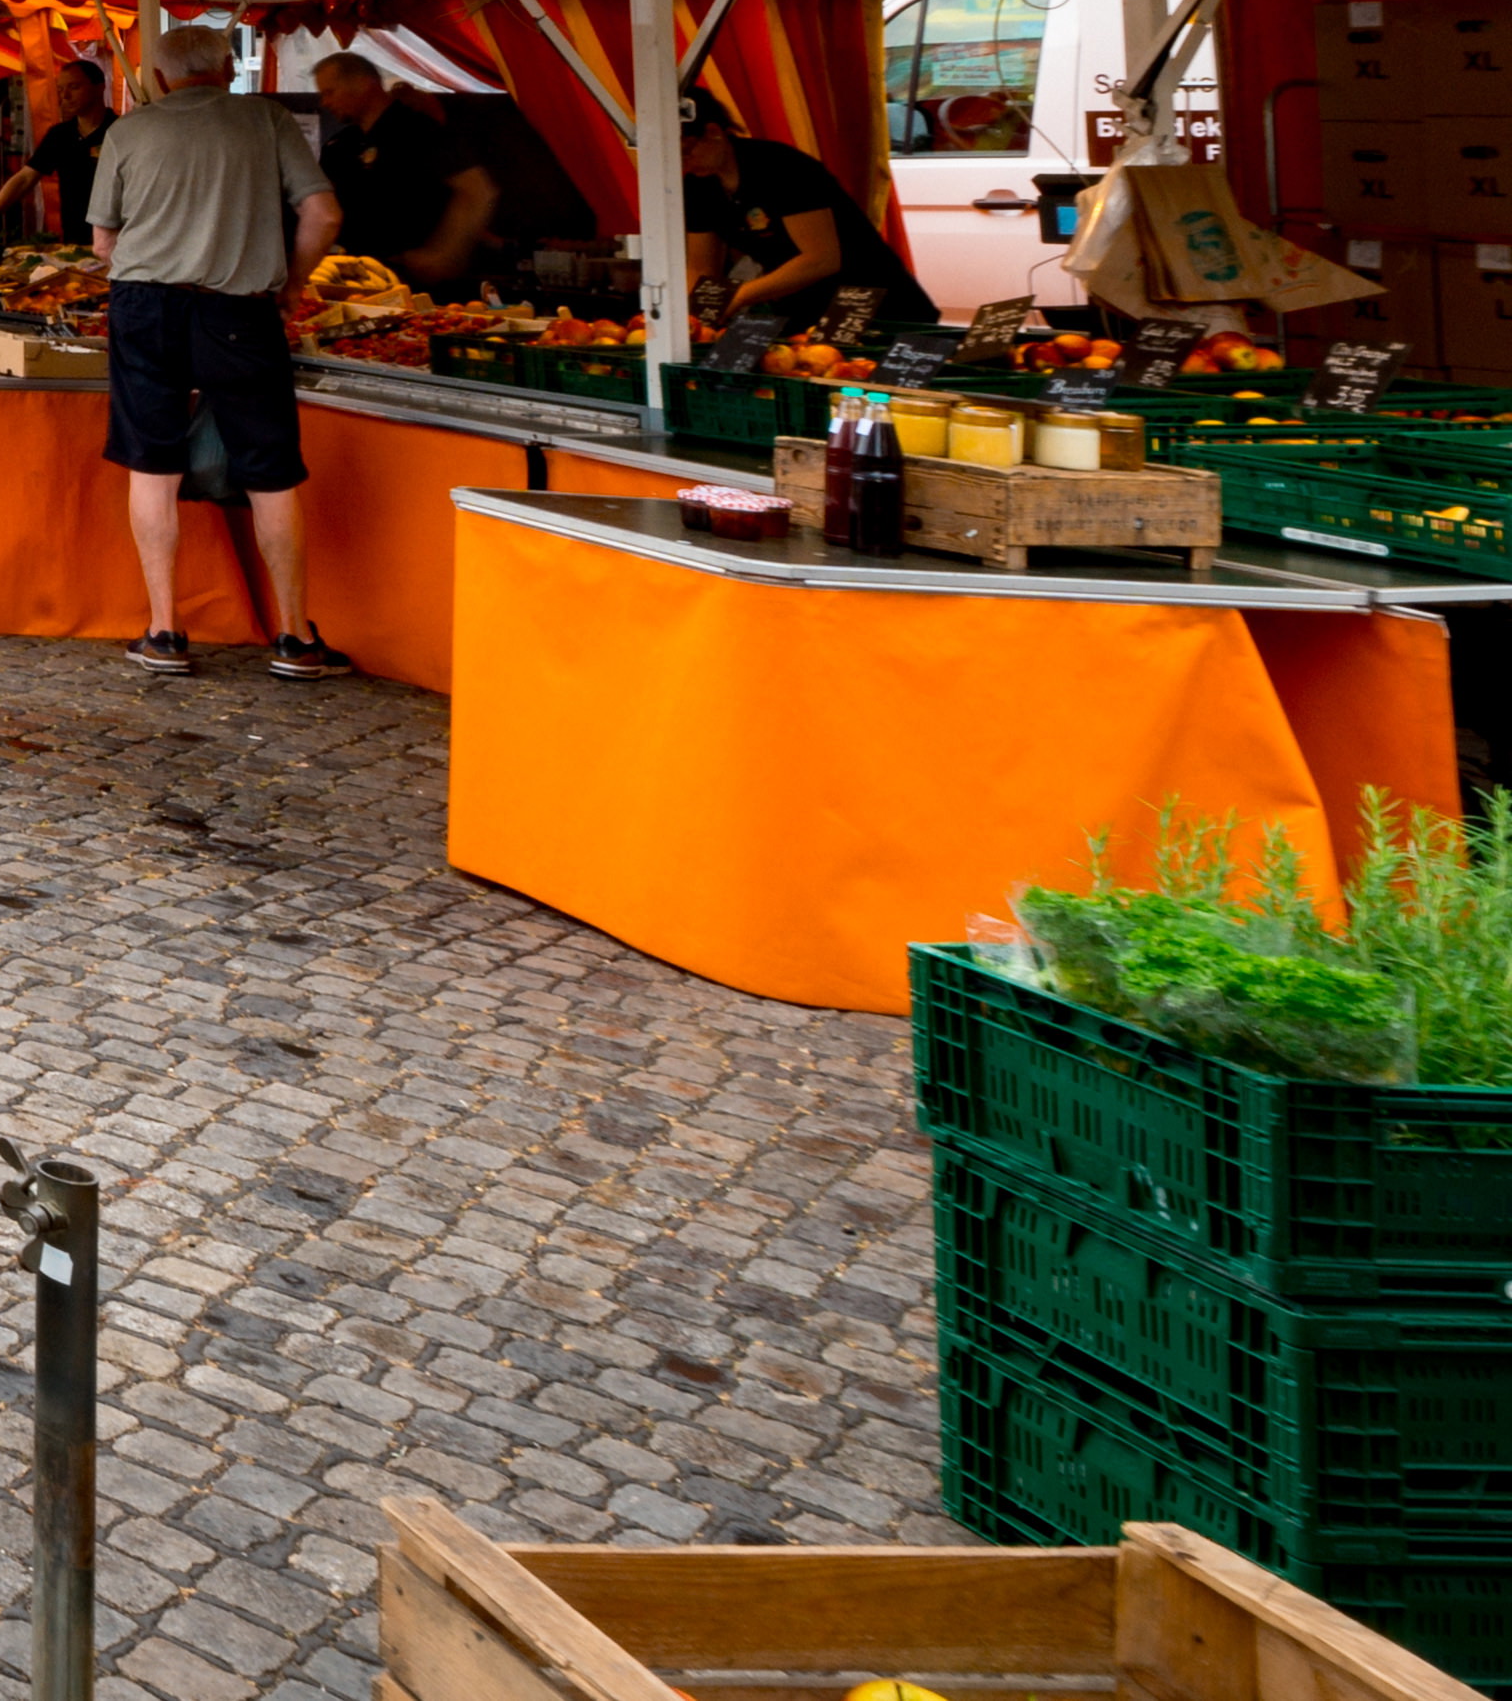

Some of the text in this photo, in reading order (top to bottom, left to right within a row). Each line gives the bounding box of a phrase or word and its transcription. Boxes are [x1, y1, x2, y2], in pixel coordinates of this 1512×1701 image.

[1355, 59, 1391, 81] XL
[1464, 50, 1504, 72] XL
[1359, 178, 1395, 200] XL
[1468, 176, 1508, 198] XL
[1353, 299, 1390, 322] XL
